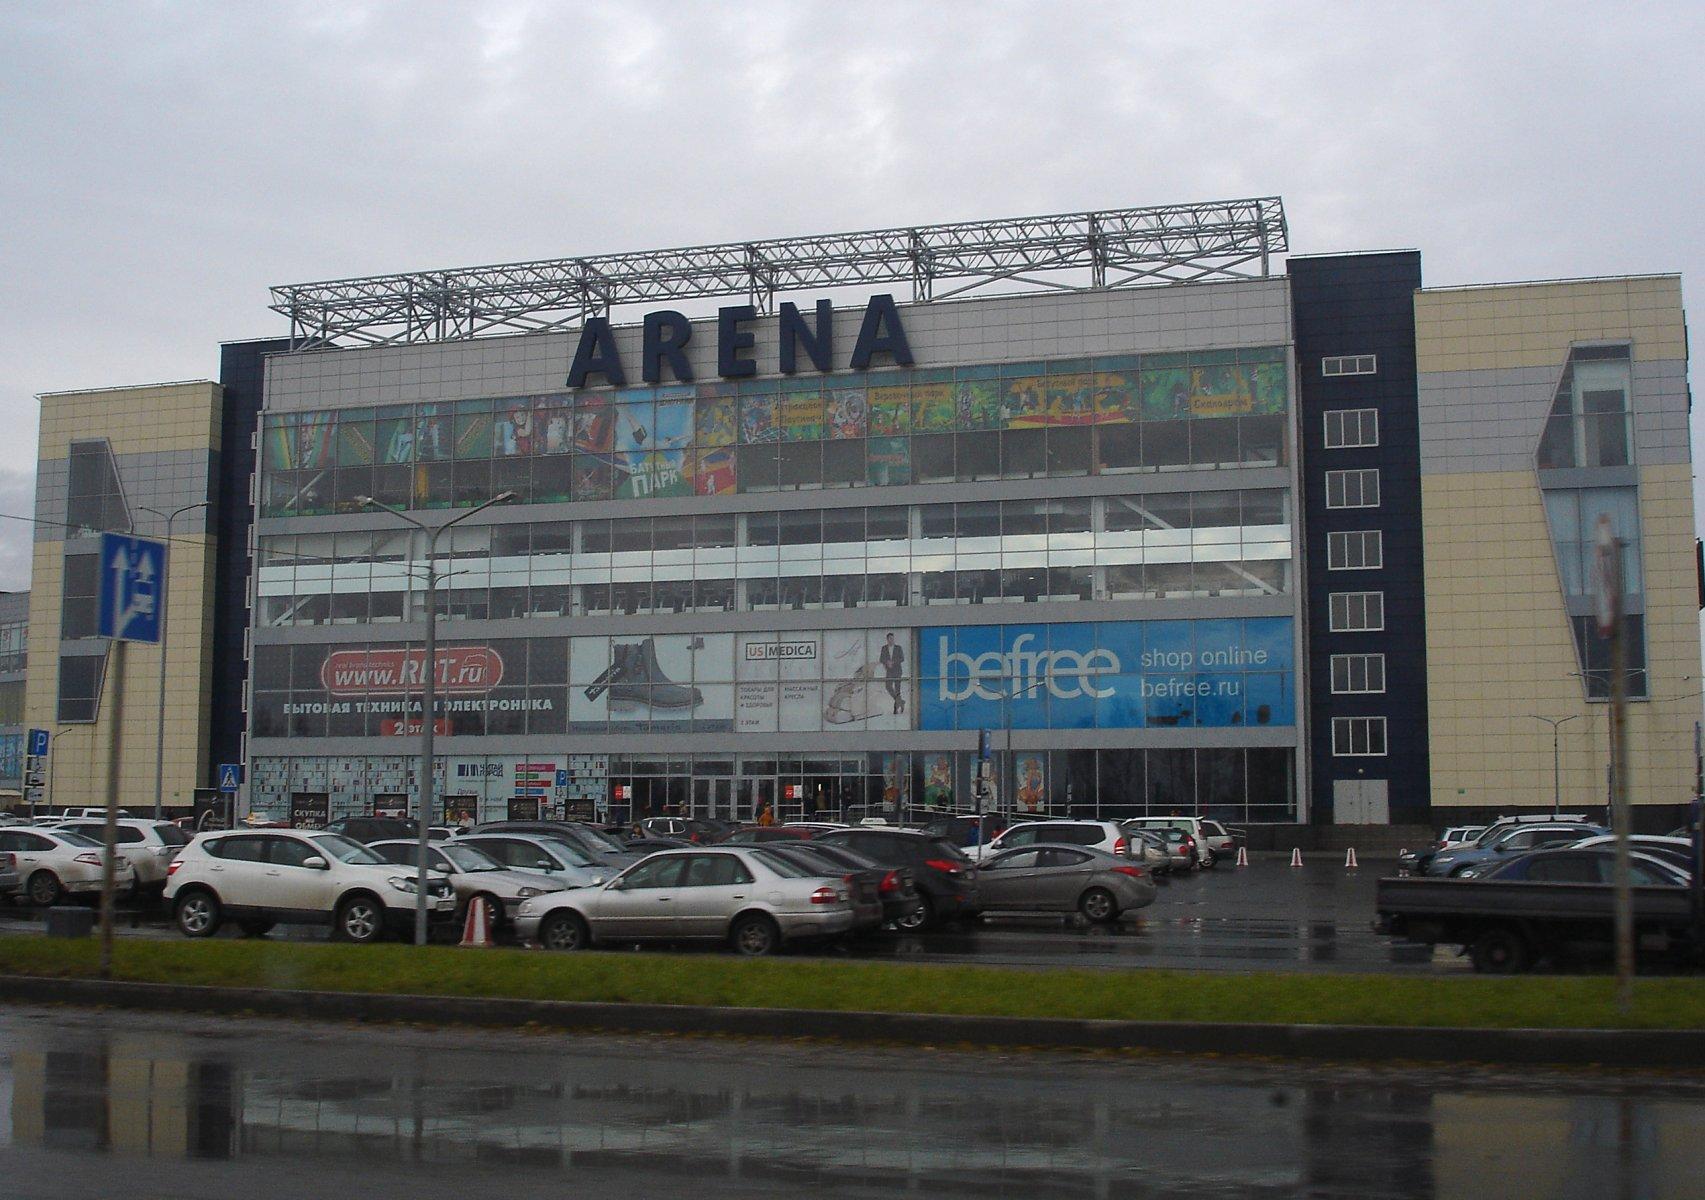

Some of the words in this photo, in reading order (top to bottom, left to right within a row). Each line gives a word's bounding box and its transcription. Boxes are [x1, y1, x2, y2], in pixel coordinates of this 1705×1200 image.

[566, 294, 915, 388] ARENA
[749, 647, 764, 657] US
[769, 646, 813, 656] MEDICA
[1140, 648, 1193, 671] shop
[1200, 646, 1268, 667] online
[938, 633, 1121, 702] befree
[1140, 677, 1240, 698] befree.ru
[283, 702, 350, 714] БЫТОВАЯ
[355, 700, 422, 713] ТЕХНИКА
[394, 722, 404, 735] 2
[294, 809, 326, 818] СКУПКА
